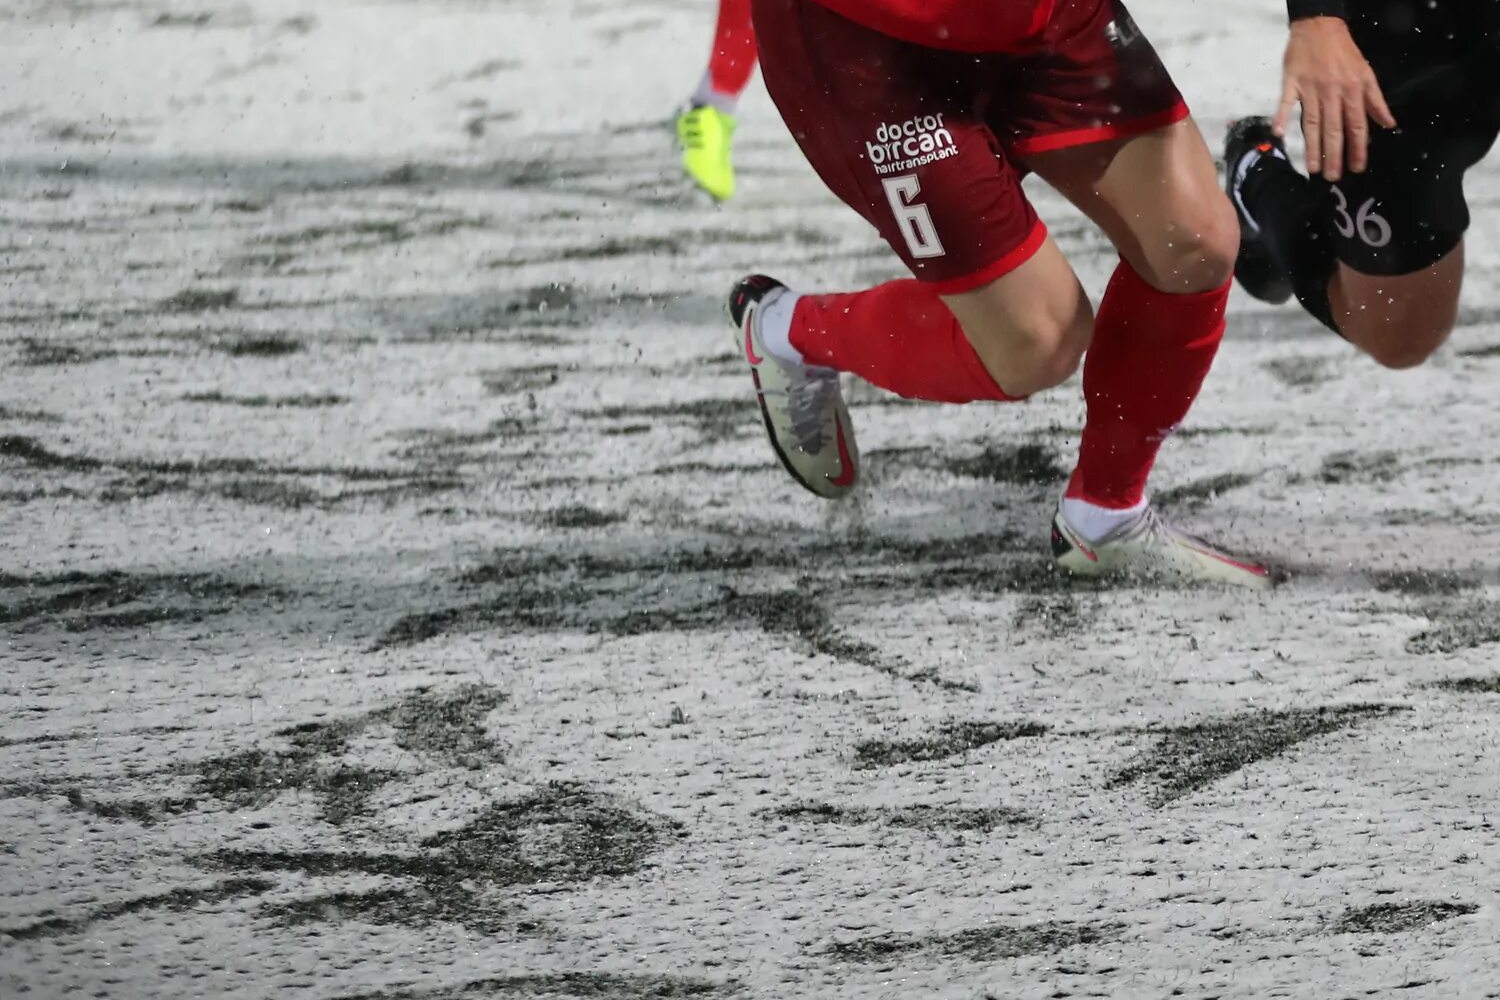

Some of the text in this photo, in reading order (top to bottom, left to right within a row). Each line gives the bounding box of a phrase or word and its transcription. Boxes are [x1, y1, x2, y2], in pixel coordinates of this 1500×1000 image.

[876, 112, 944, 143] doctor
[866, 128, 953, 164] bircan
[874, 145, 959, 175] hairtransplant
[881, 173, 946, 259] 6
[1330, 184, 1392, 248] 36
